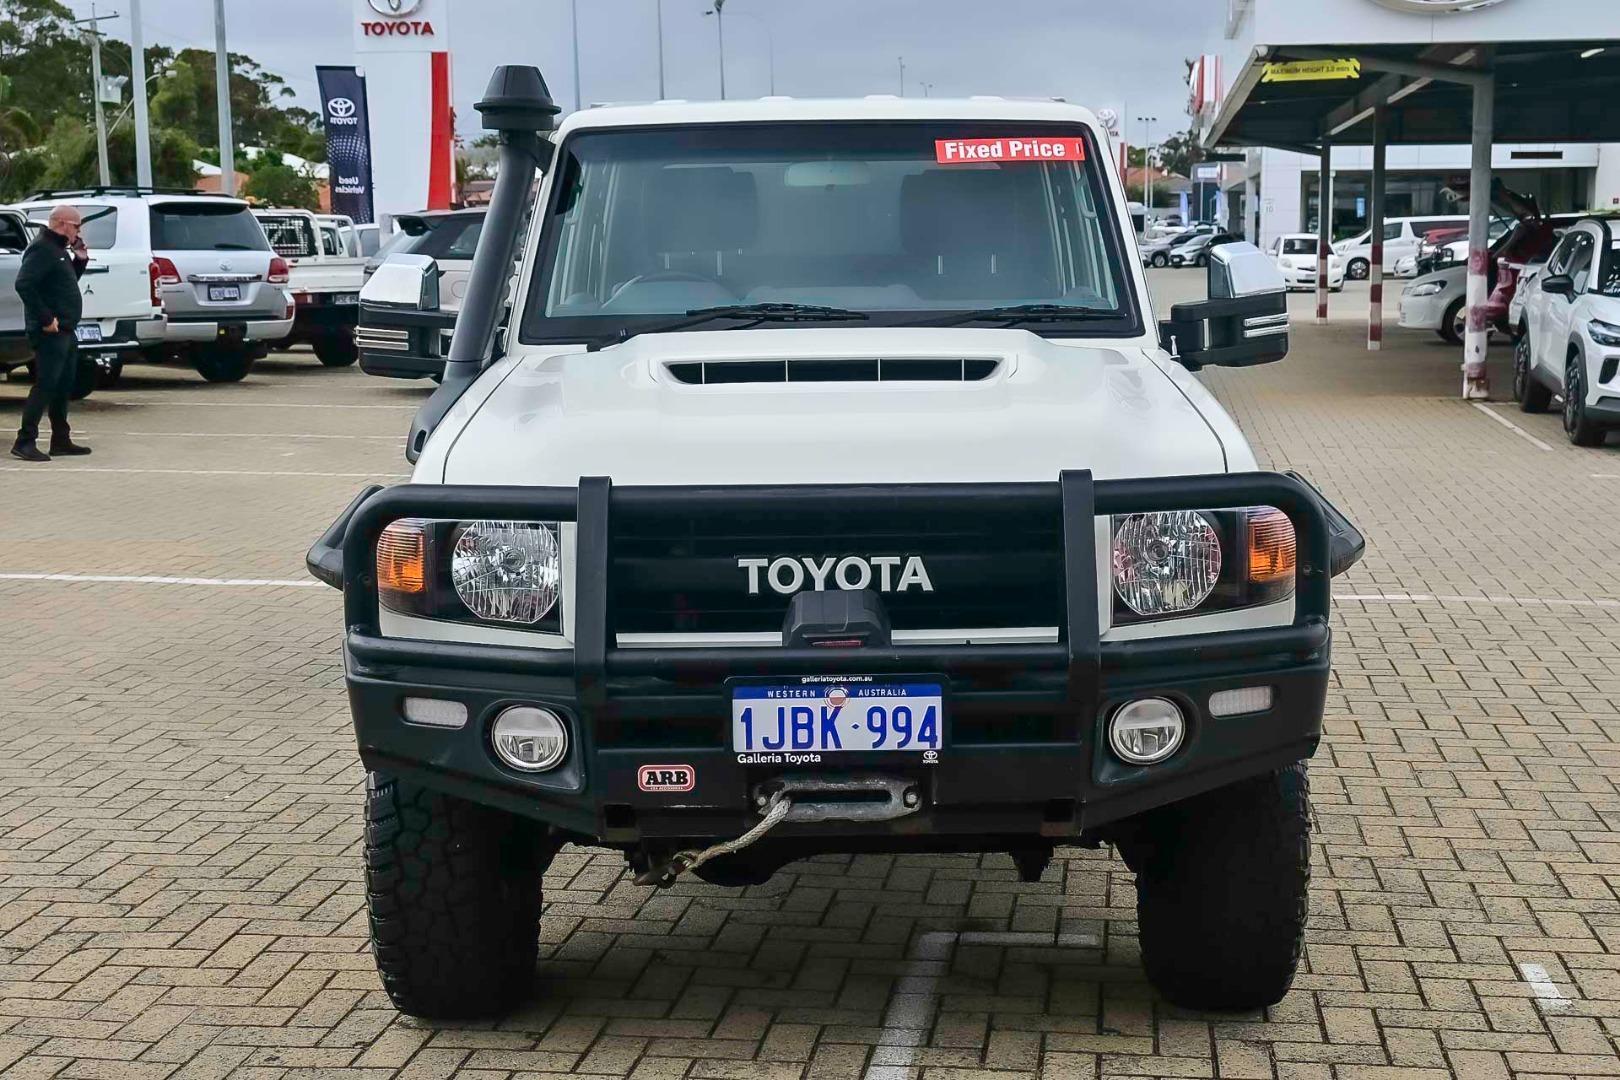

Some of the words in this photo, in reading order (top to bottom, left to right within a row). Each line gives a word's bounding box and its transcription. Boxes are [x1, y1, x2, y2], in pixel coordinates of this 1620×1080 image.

[361, 21, 434, 36] TOYOTA
[944, 140, 1003, 159] Fixed
[1009, 139, 1066, 157] Price
[737, 556, 934, 594] TOYOTA
[801, 675, 873, 684] galleriatoyota.com.au
[767, 690, 816, 698] WESTERN
[858, 688, 907, 697] AUSTRALIA
[737, 753, 782, 764] Galleria
[784, 752, 821, 765] Toyota
[645, 771, 689, 785] ARB
